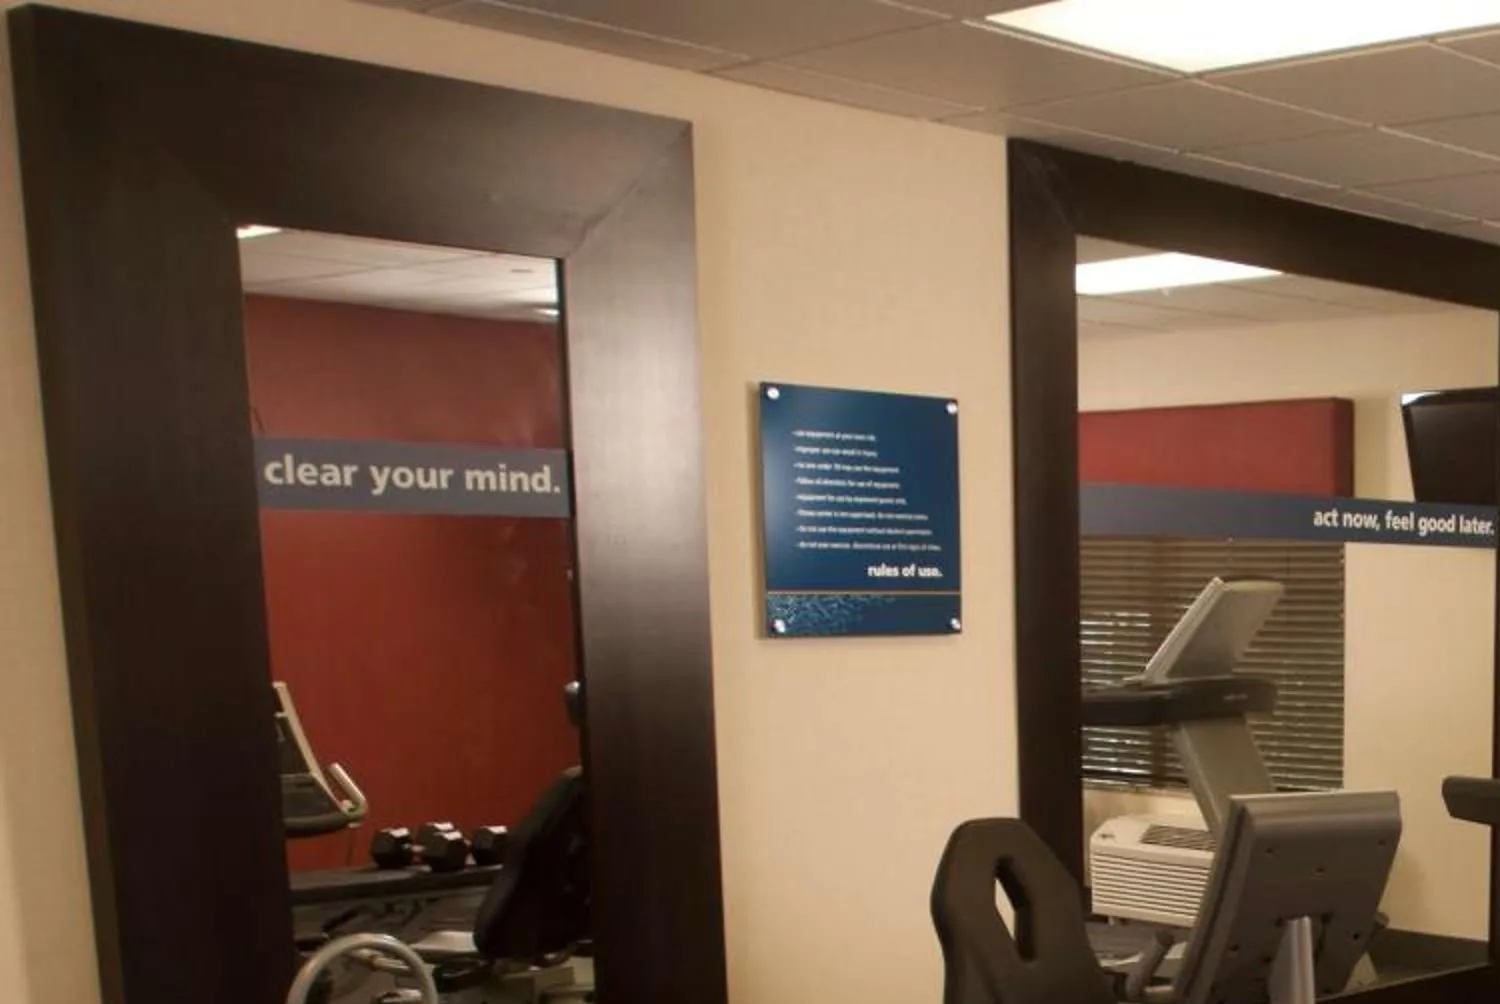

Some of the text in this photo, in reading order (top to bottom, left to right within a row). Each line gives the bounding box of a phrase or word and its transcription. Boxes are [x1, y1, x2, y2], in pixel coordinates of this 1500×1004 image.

[264, 453, 560, 495] clear your mind.
[1313, 508, 1495, 536] act now, feel good later.
[867, 562, 943, 577] rules of use.
